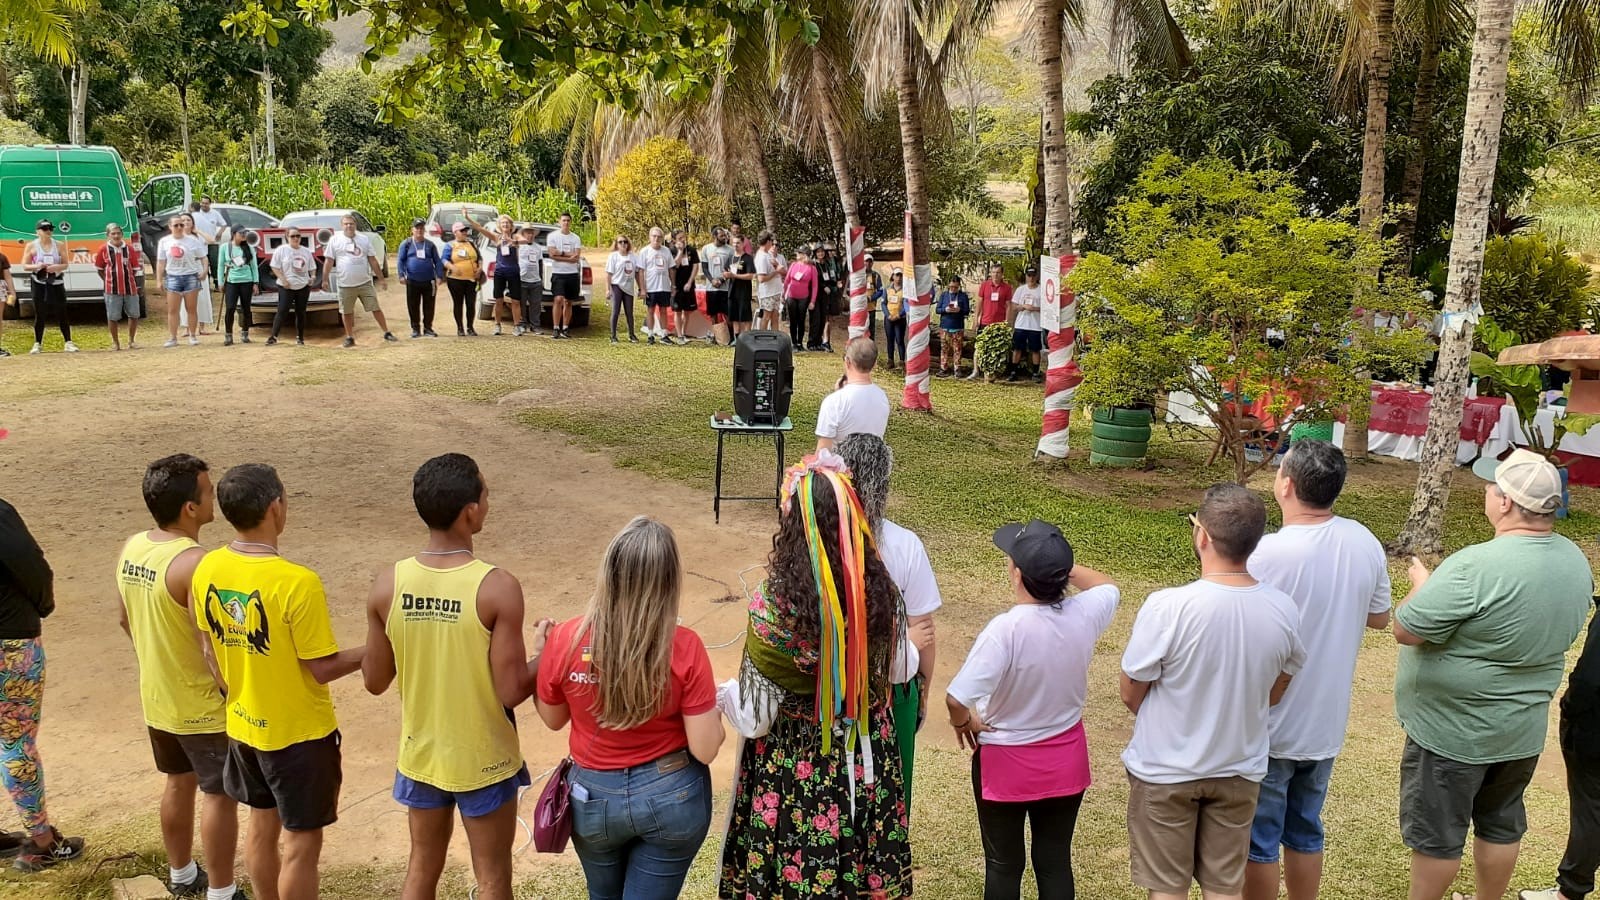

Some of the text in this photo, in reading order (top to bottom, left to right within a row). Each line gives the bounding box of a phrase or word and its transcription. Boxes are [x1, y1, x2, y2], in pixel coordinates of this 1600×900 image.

[29, 191, 77, 200] Unimed
[122, 559, 157, 582] Derson
[402, 593, 461, 613] Derson
